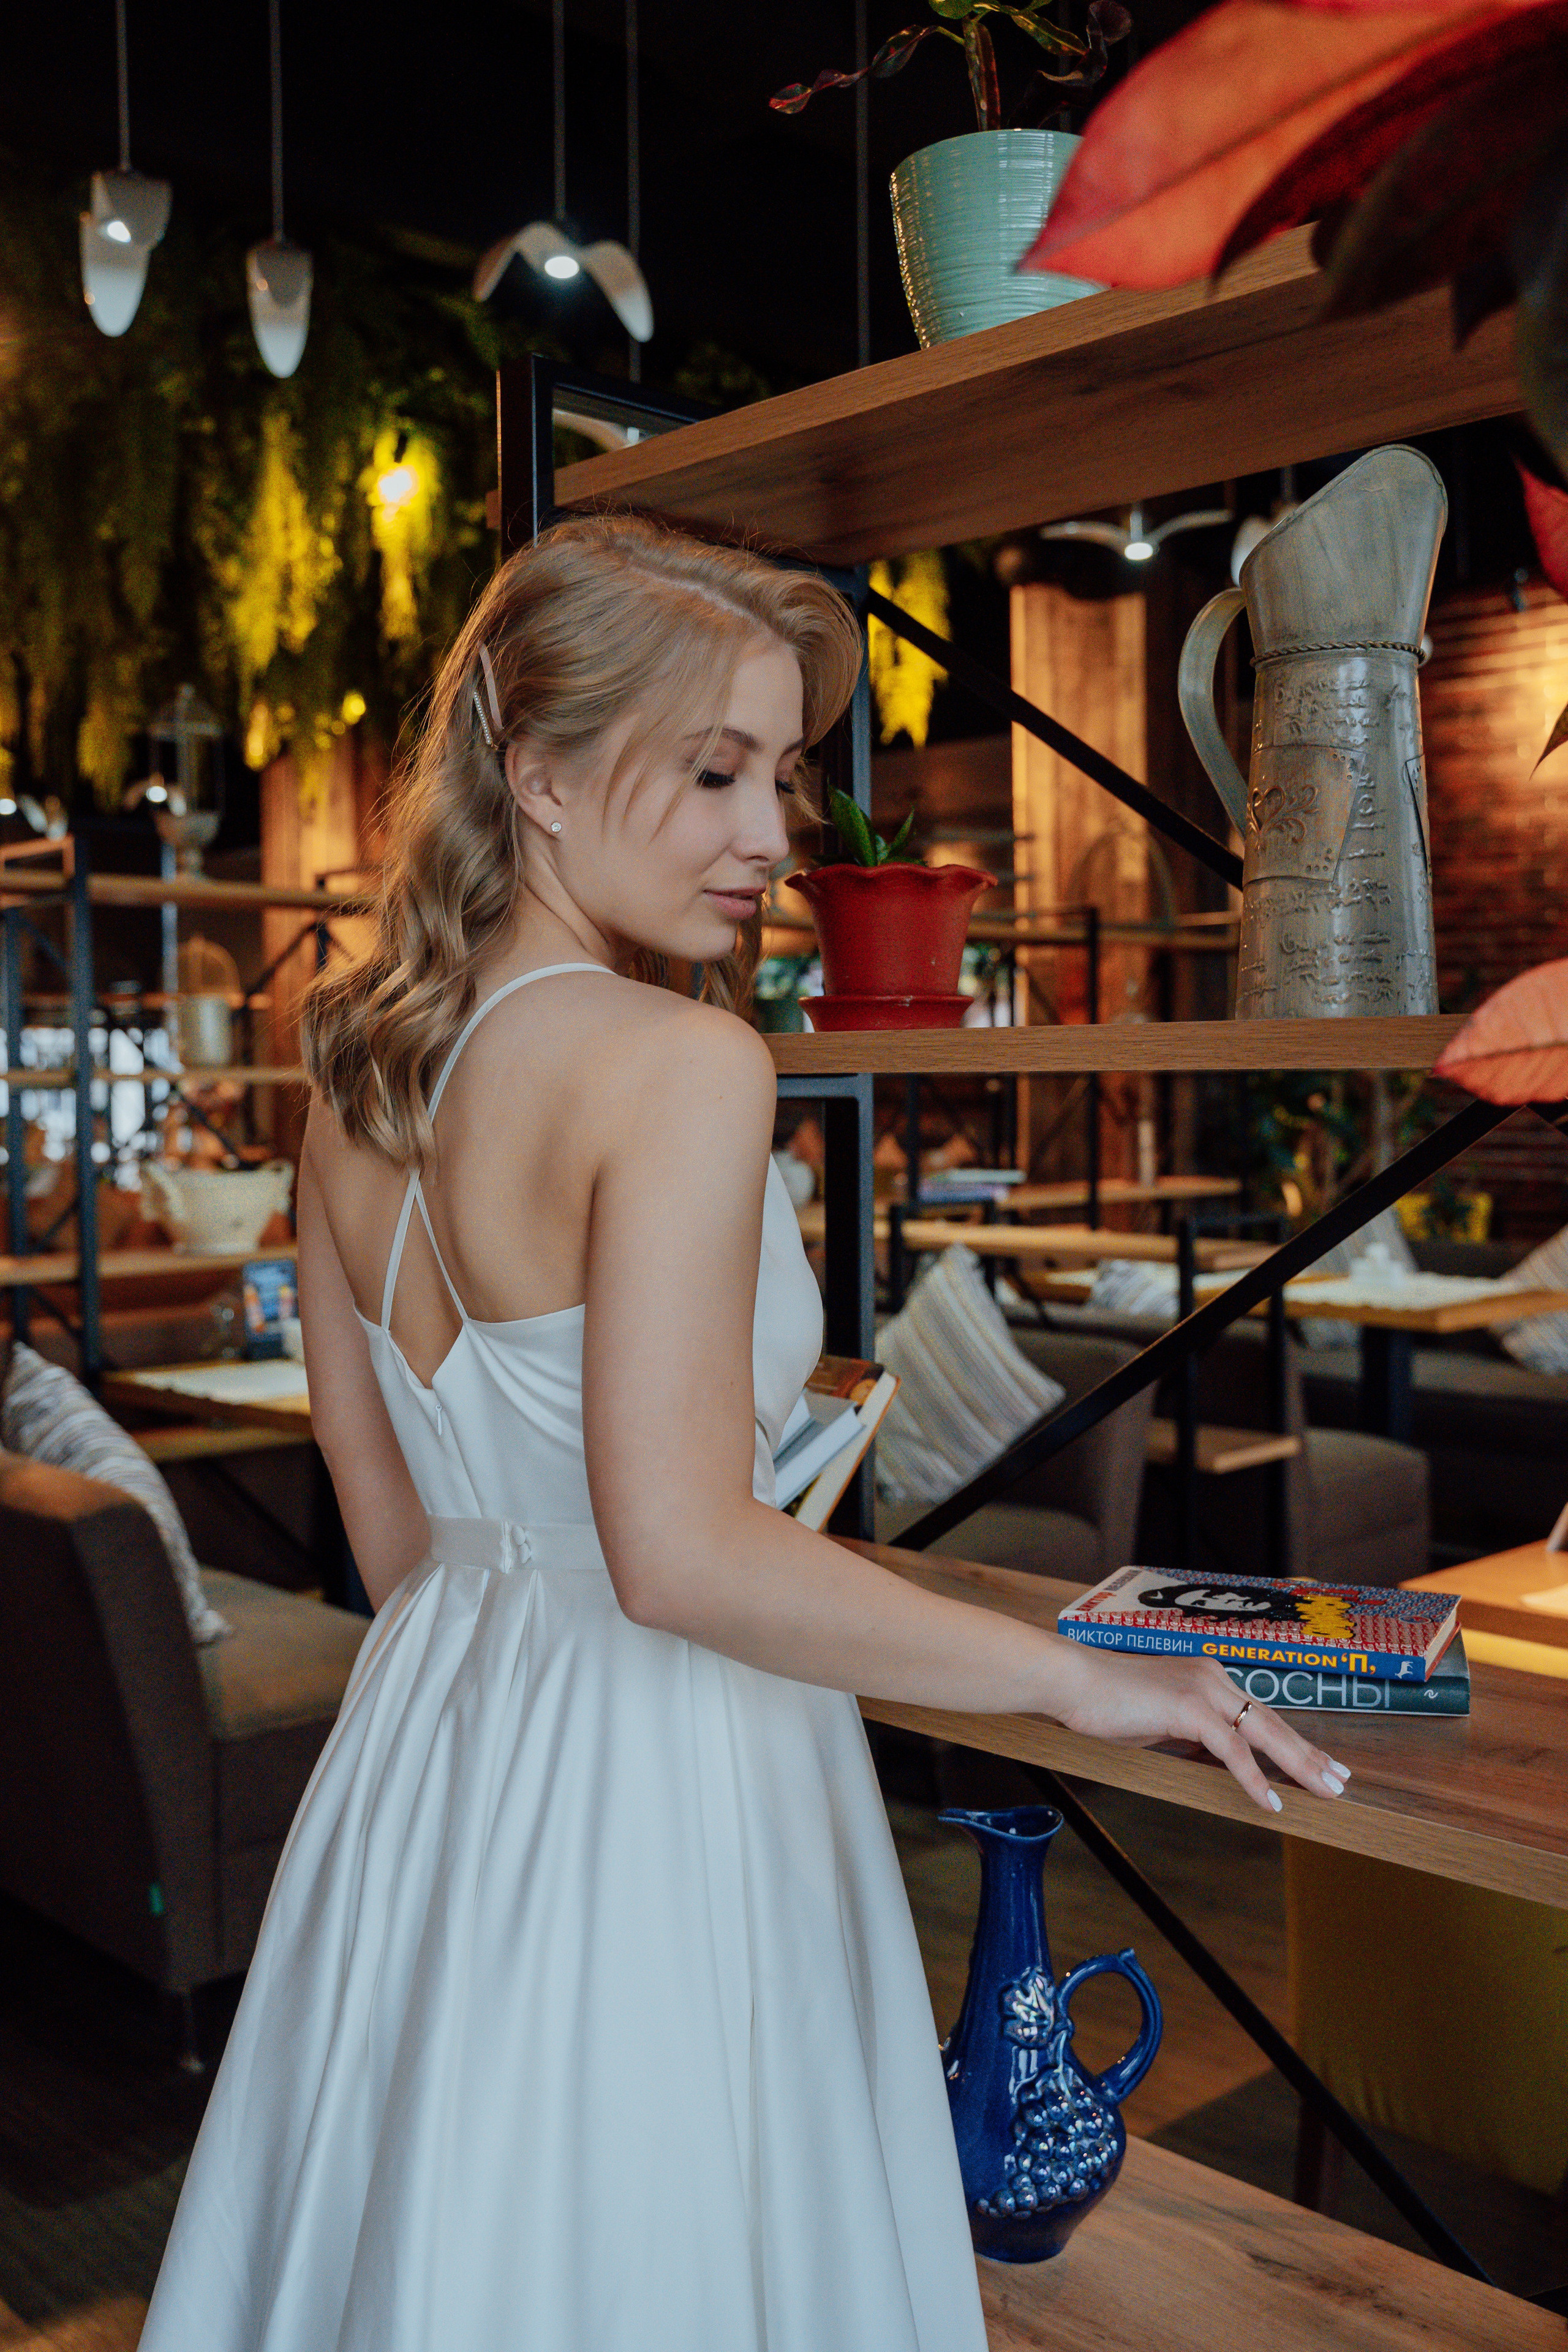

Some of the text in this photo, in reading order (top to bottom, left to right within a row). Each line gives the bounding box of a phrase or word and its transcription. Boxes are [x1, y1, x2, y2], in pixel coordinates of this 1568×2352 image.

[1068, 1628, 1193, 1653] ВИКТОР ПЕЛЕВИН
[1202, 1643, 1338, 1668] GENERATION
